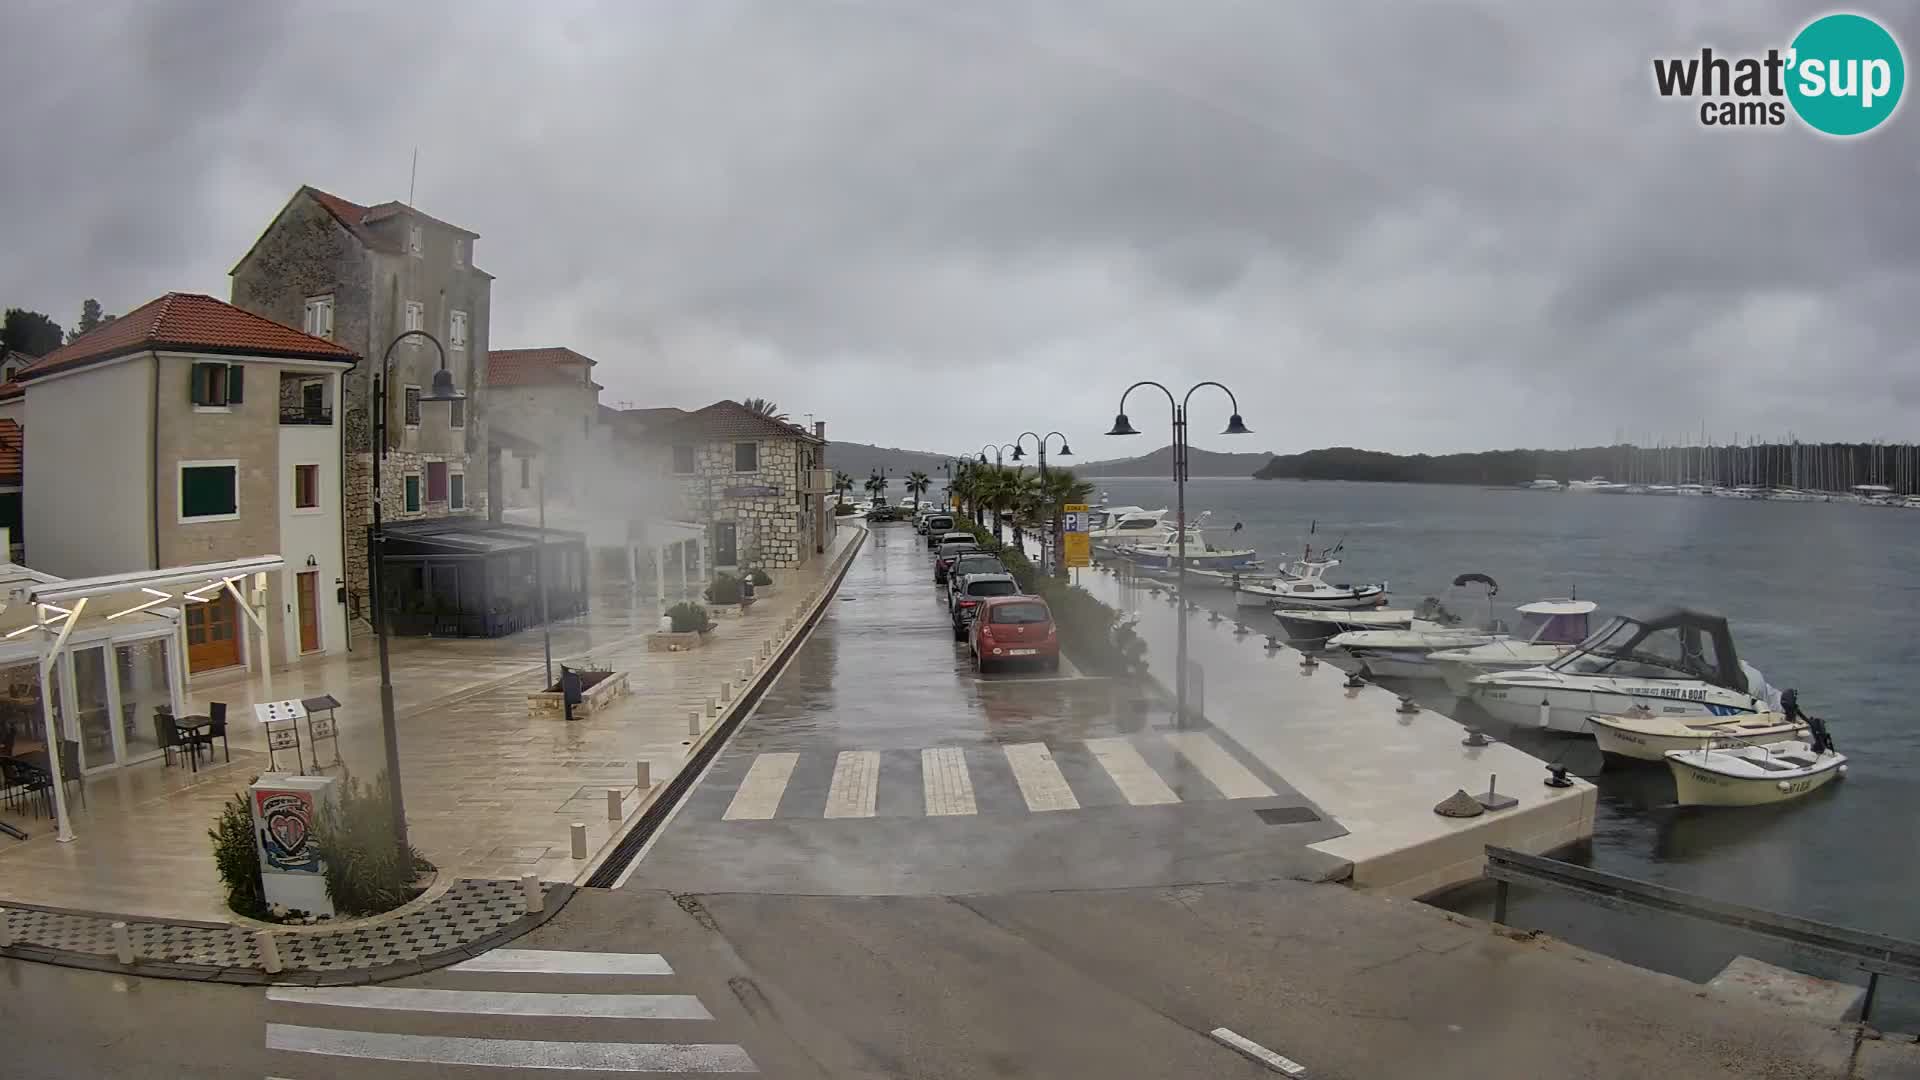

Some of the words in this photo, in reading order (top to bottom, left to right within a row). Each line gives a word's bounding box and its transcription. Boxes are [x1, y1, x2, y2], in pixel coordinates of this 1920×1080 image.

[1660, 688, 1681, 698] RENT
[1681, 689, 1688, 699] A
[1688, 689, 1708, 700] BOAT
